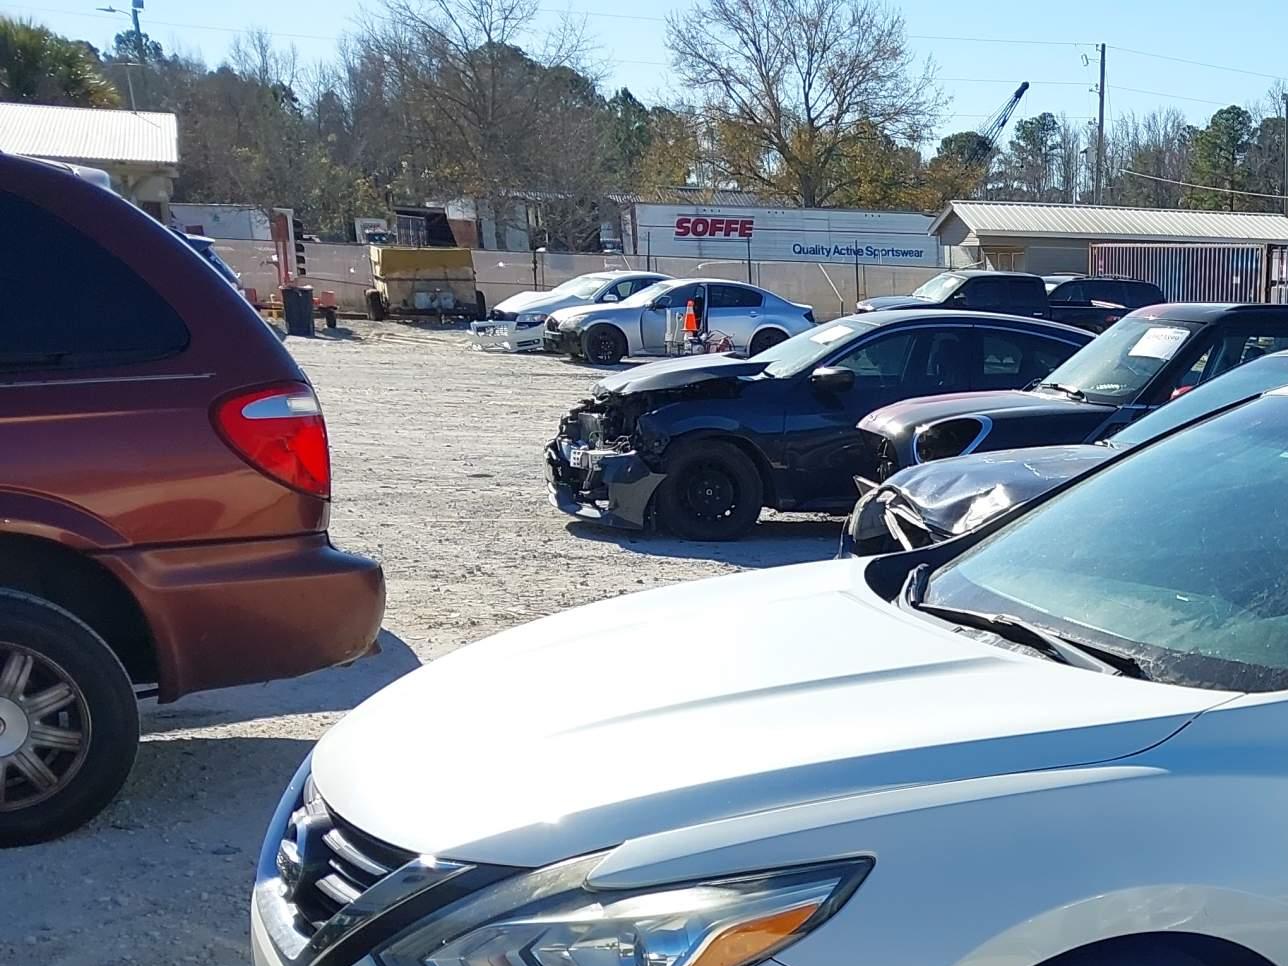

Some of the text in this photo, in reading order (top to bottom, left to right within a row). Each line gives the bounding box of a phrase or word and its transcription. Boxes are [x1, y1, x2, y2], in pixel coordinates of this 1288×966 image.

[675, 217, 754, 238] SOFFE
[792, 243, 924, 259] Quality Active Sportswear
